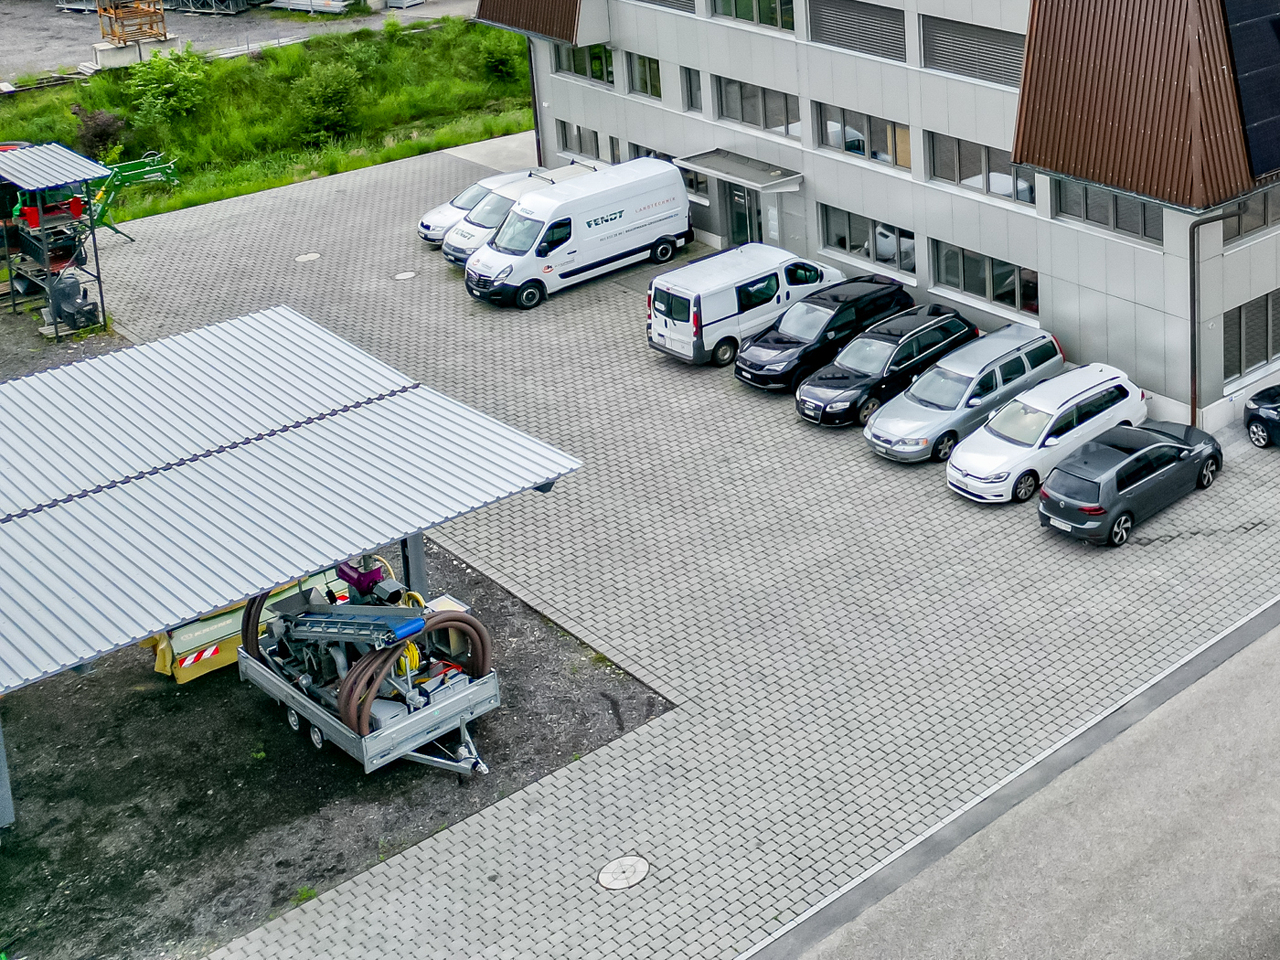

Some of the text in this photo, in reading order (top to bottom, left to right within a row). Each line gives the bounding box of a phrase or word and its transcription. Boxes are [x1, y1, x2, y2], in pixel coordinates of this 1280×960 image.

[634, 197, 676, 213] LANDTECHNIK
[585, 209, 625, 229] FENDT
[194, 618, 233, 637] KRONE
